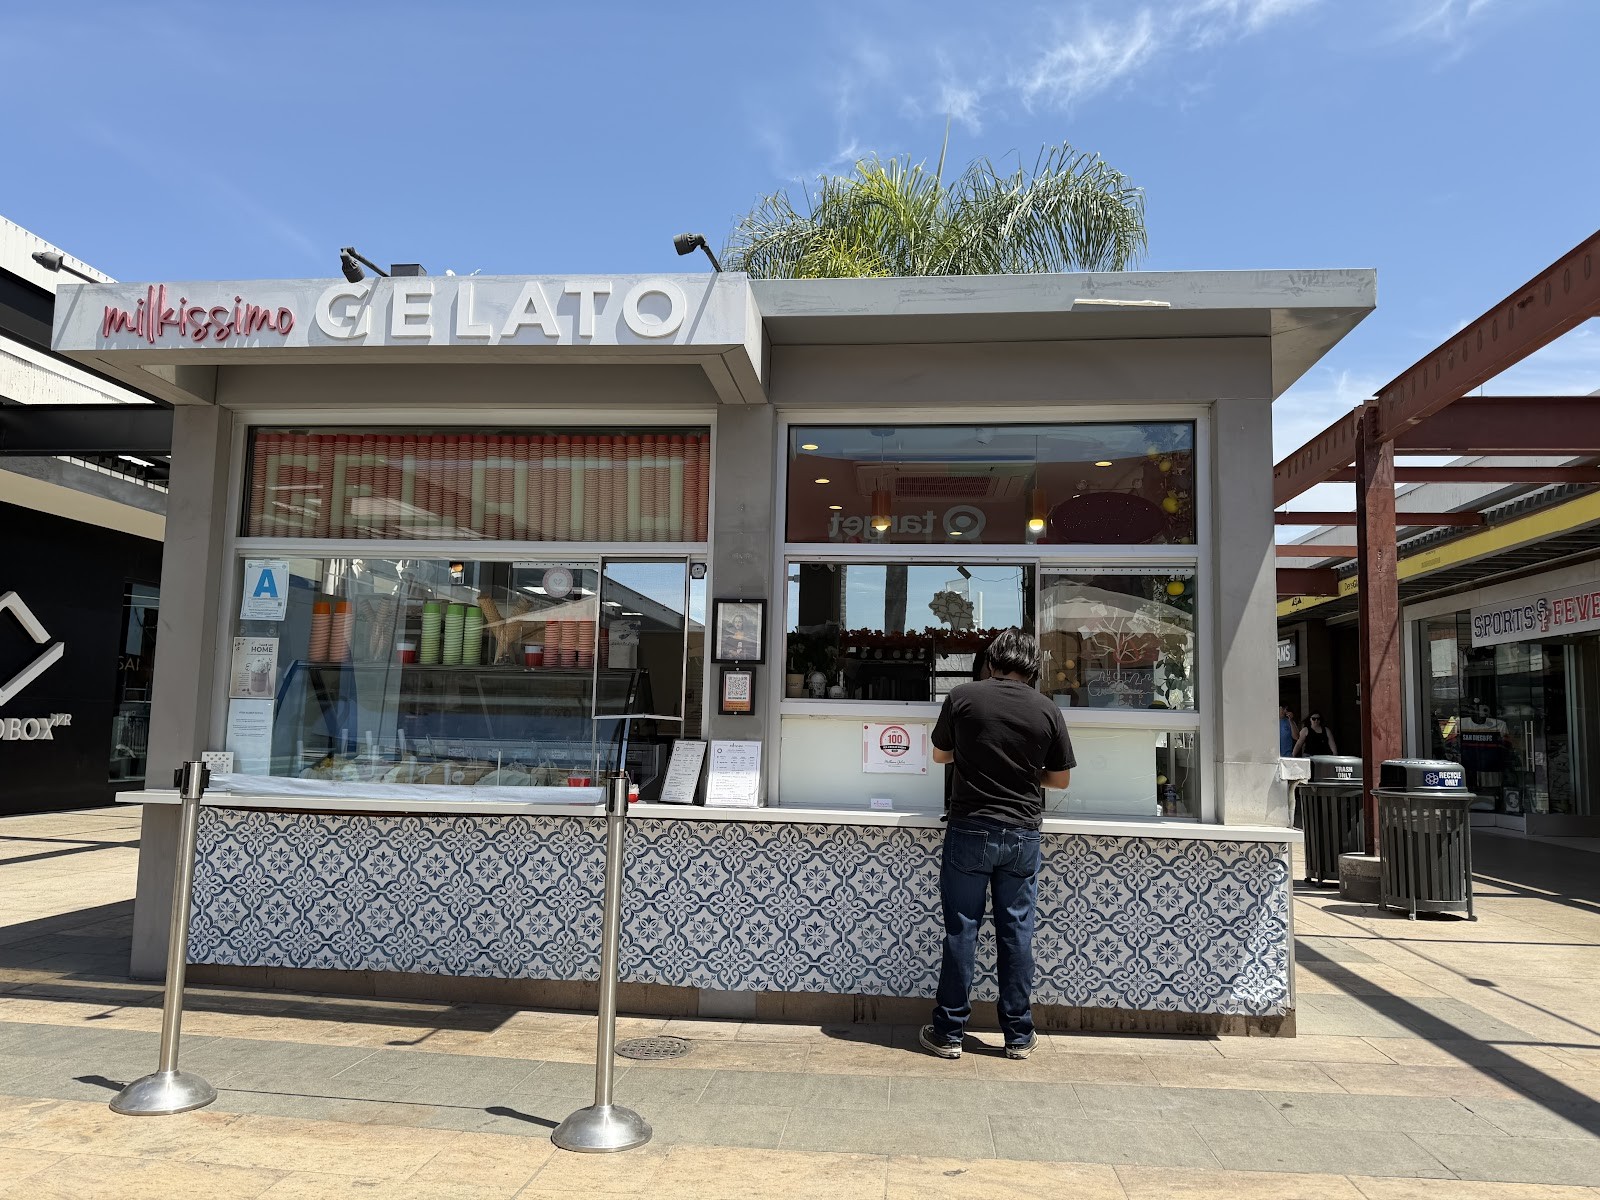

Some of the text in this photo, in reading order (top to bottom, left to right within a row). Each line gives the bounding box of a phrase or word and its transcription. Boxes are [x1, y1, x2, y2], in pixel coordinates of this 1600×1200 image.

[103, 280, 686, 344] milkissimo GELATO
[253, 569, 279, 598] A
[1474, 606, 1534, 638] SPORTS
[50, 712, 73, 727] VR
[888, 735, 902, 744] 100
